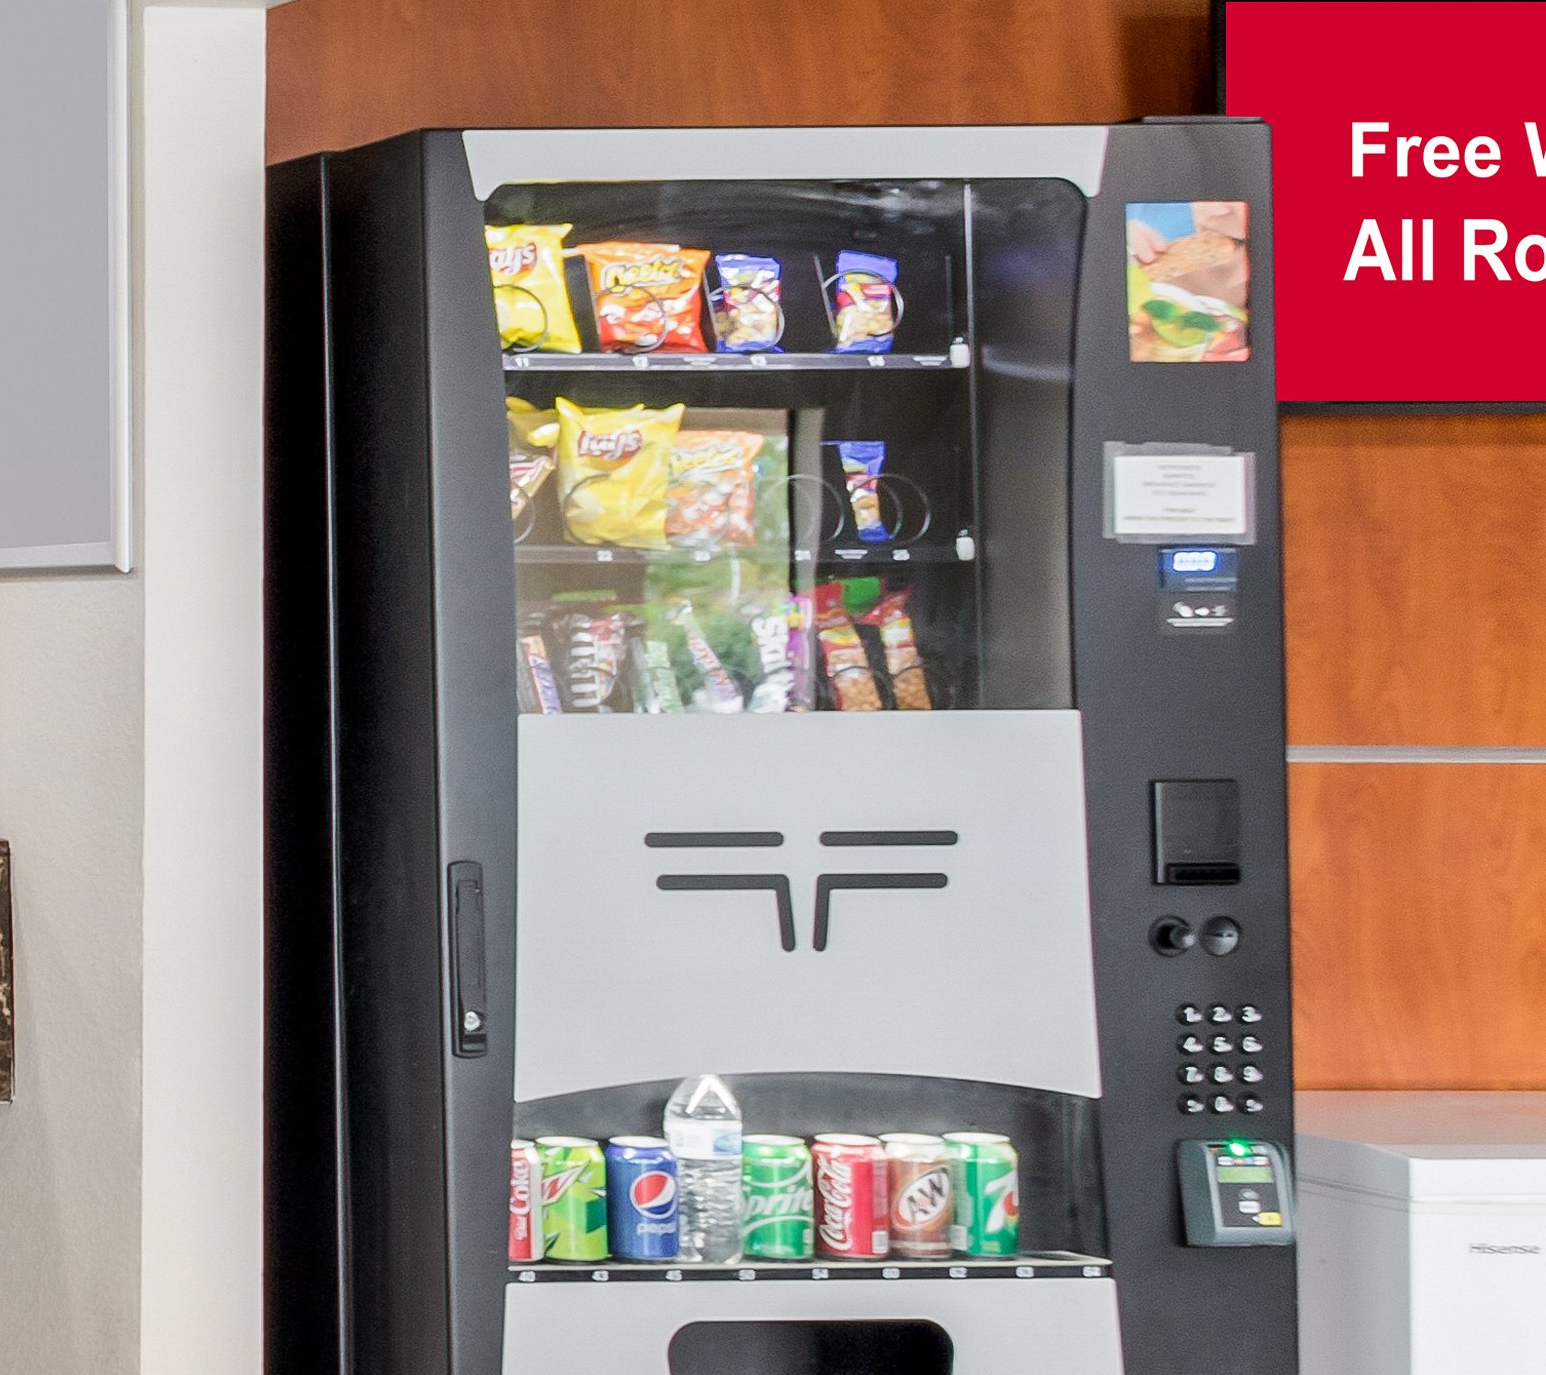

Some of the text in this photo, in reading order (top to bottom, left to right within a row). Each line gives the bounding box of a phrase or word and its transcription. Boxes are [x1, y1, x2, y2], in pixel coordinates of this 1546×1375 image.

[1352, 122, 1501, 178] Free
[1343, 219, 1546, 282] All Ro
[1467, 1243, 1540, 1254] Hisense
